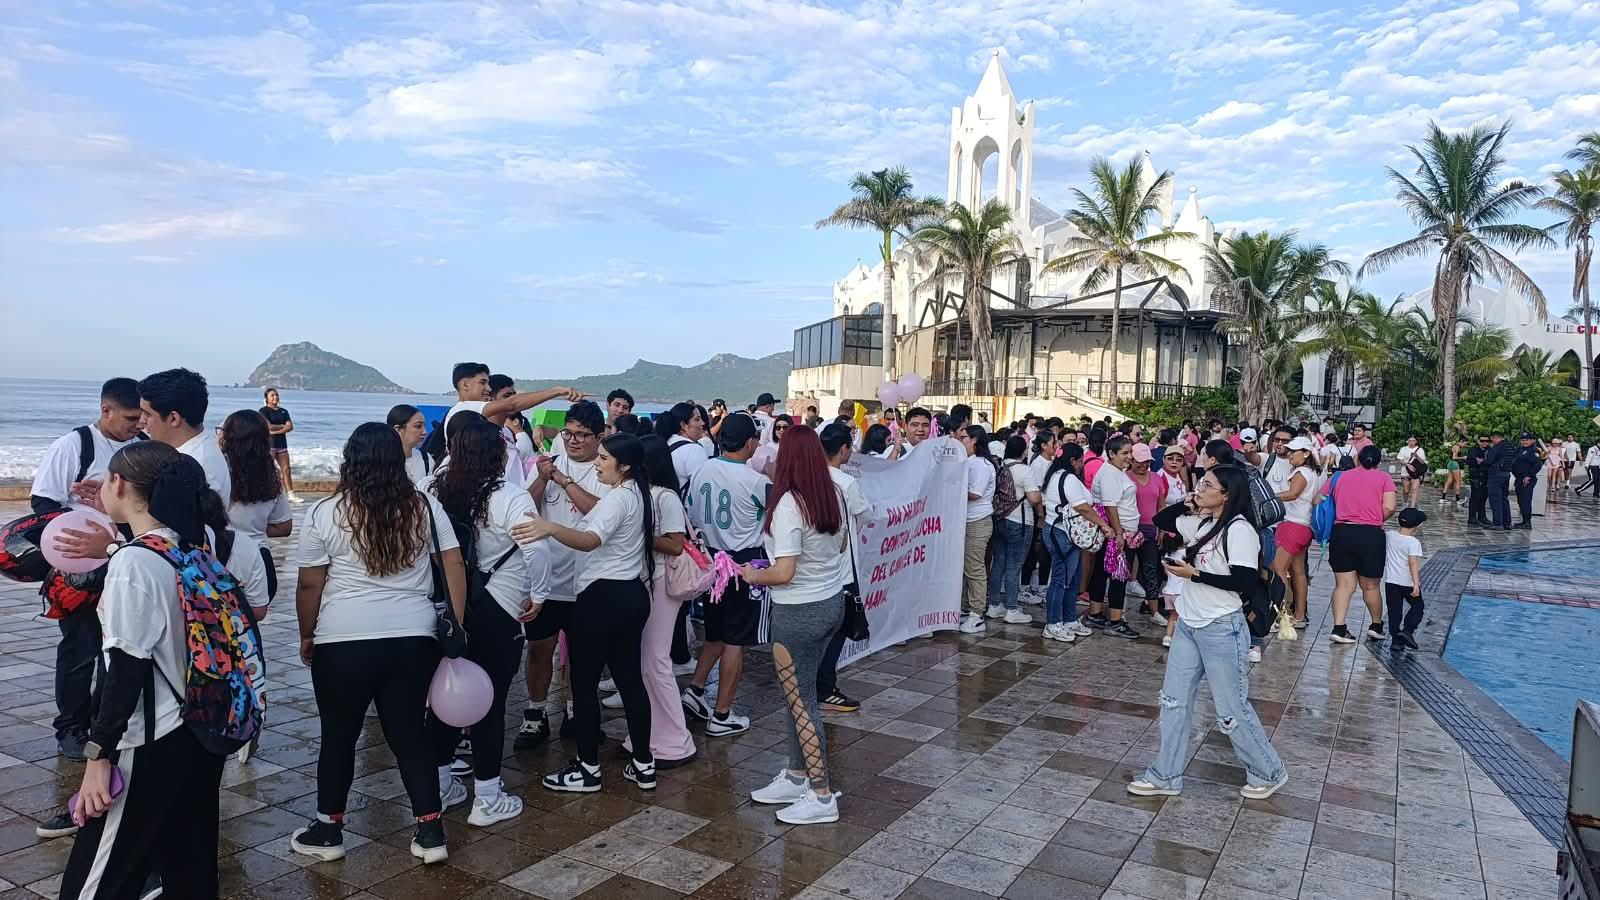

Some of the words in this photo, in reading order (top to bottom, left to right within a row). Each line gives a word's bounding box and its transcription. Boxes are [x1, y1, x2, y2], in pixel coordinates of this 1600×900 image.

[699, 482, 733, 530] 18
[870, 562, 887, 584] DEL
[913, 545, 926, 564] DE
